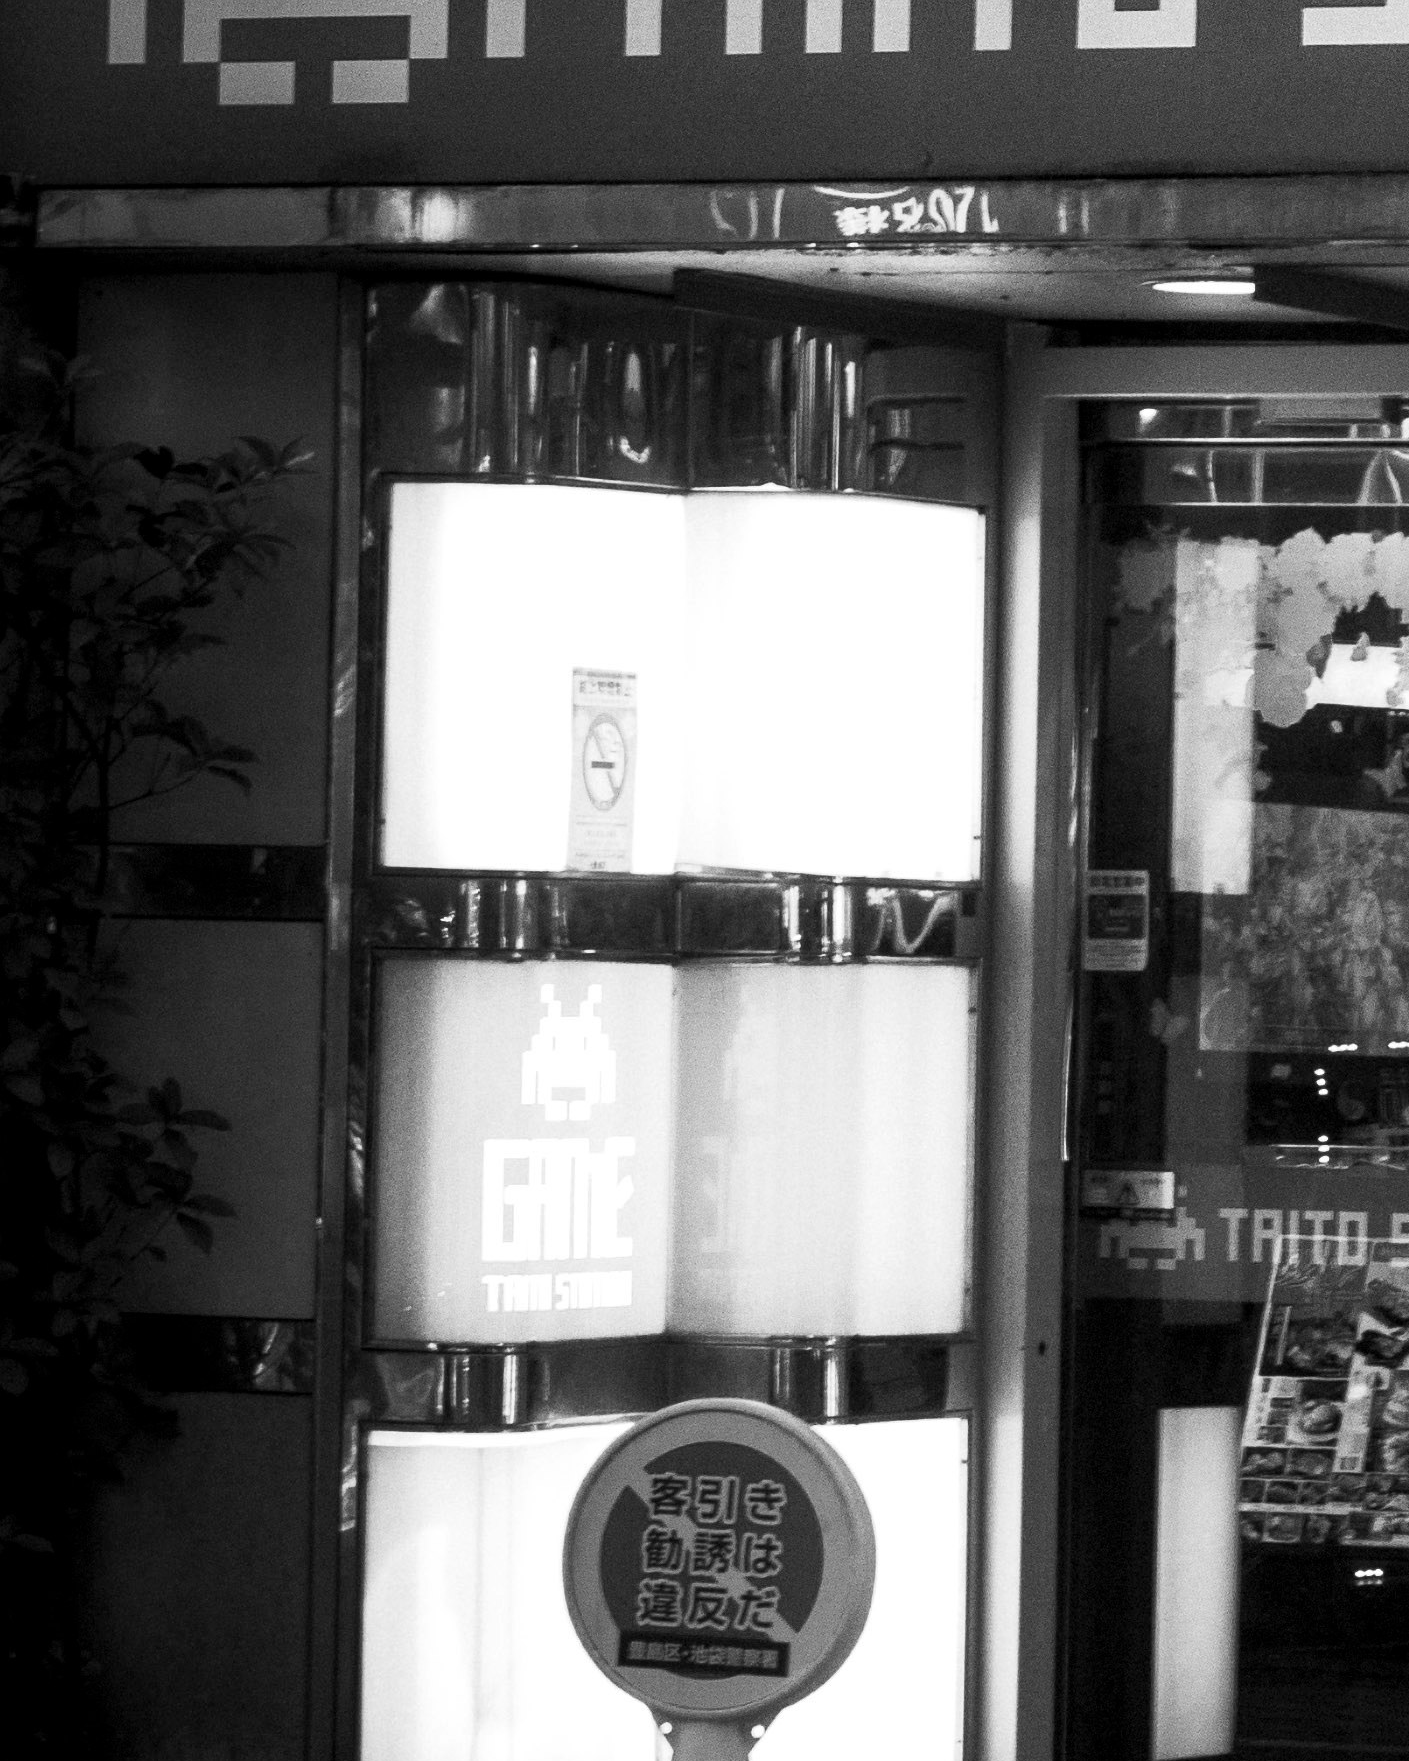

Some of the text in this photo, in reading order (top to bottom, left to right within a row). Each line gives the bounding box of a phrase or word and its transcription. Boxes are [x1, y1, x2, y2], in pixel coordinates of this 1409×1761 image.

[481, 1136, 636, 1262] GAME
[1219, 1206, 1368, 1267] TAITO
[648, 1471, 788, 1526] 客引き
[641, 1524, 783, 1579] 勧誘は
[636, 1579, 781, 1632] 違反だ
